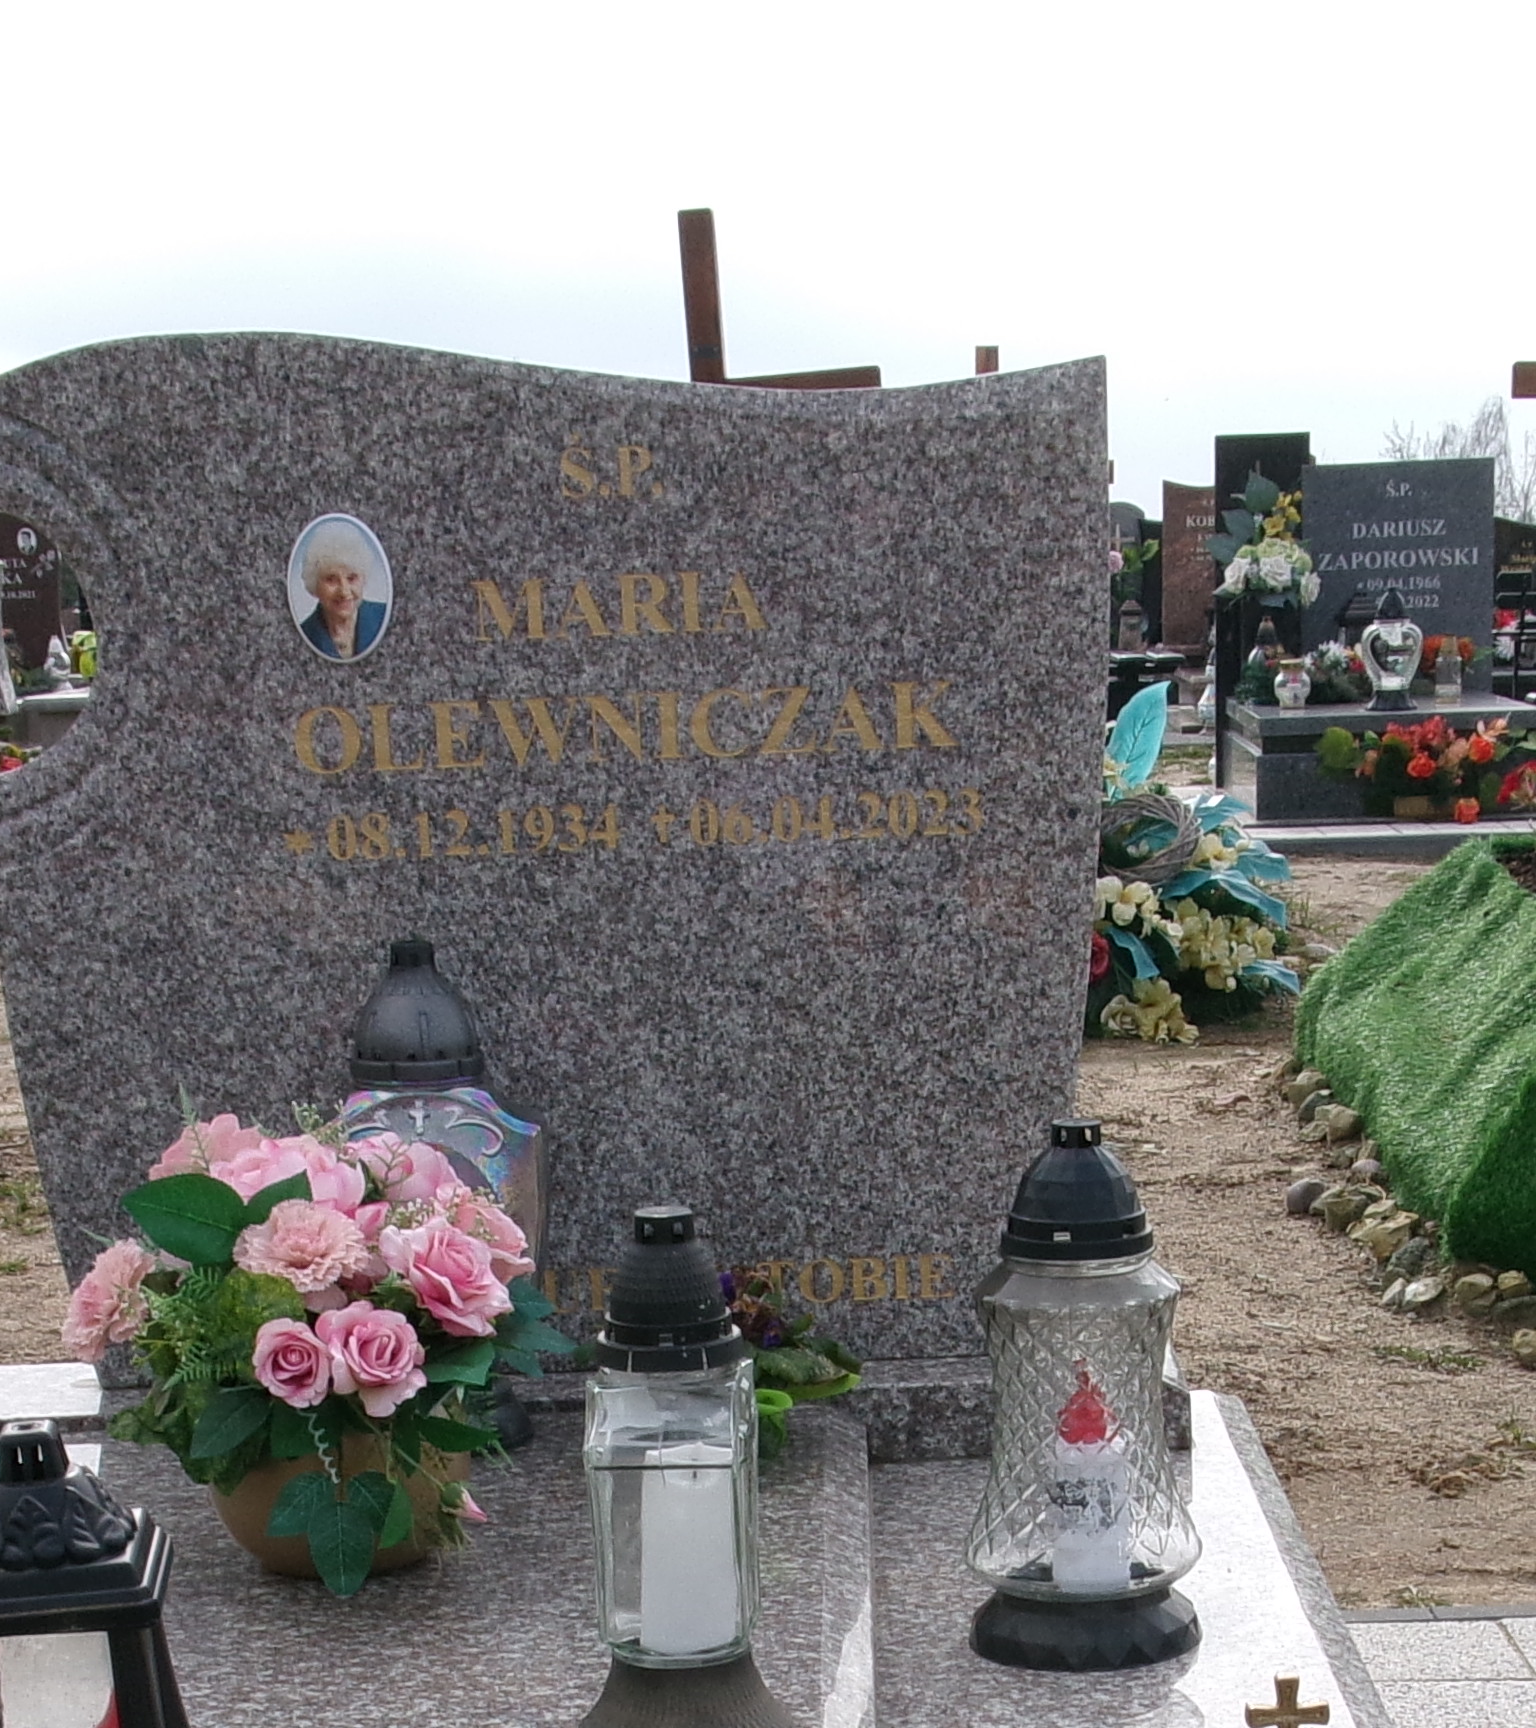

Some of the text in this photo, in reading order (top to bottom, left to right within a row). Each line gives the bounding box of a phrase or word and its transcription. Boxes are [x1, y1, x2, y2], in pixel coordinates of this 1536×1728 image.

[561, 434, 664, 501] Ś.P.
[1318, 546, 1479, 571] ZAPOROWSKI
[1352, 519, 1447, 540] DARIUSZ
[472, 572, 768, 643] MARIA
[292, 679, 962, 778] OLEWNICZAK
[325, 787, 985, 862] 08.12.1934 06.04.2023
[756, 1253, 954, 1303] TOBIE
